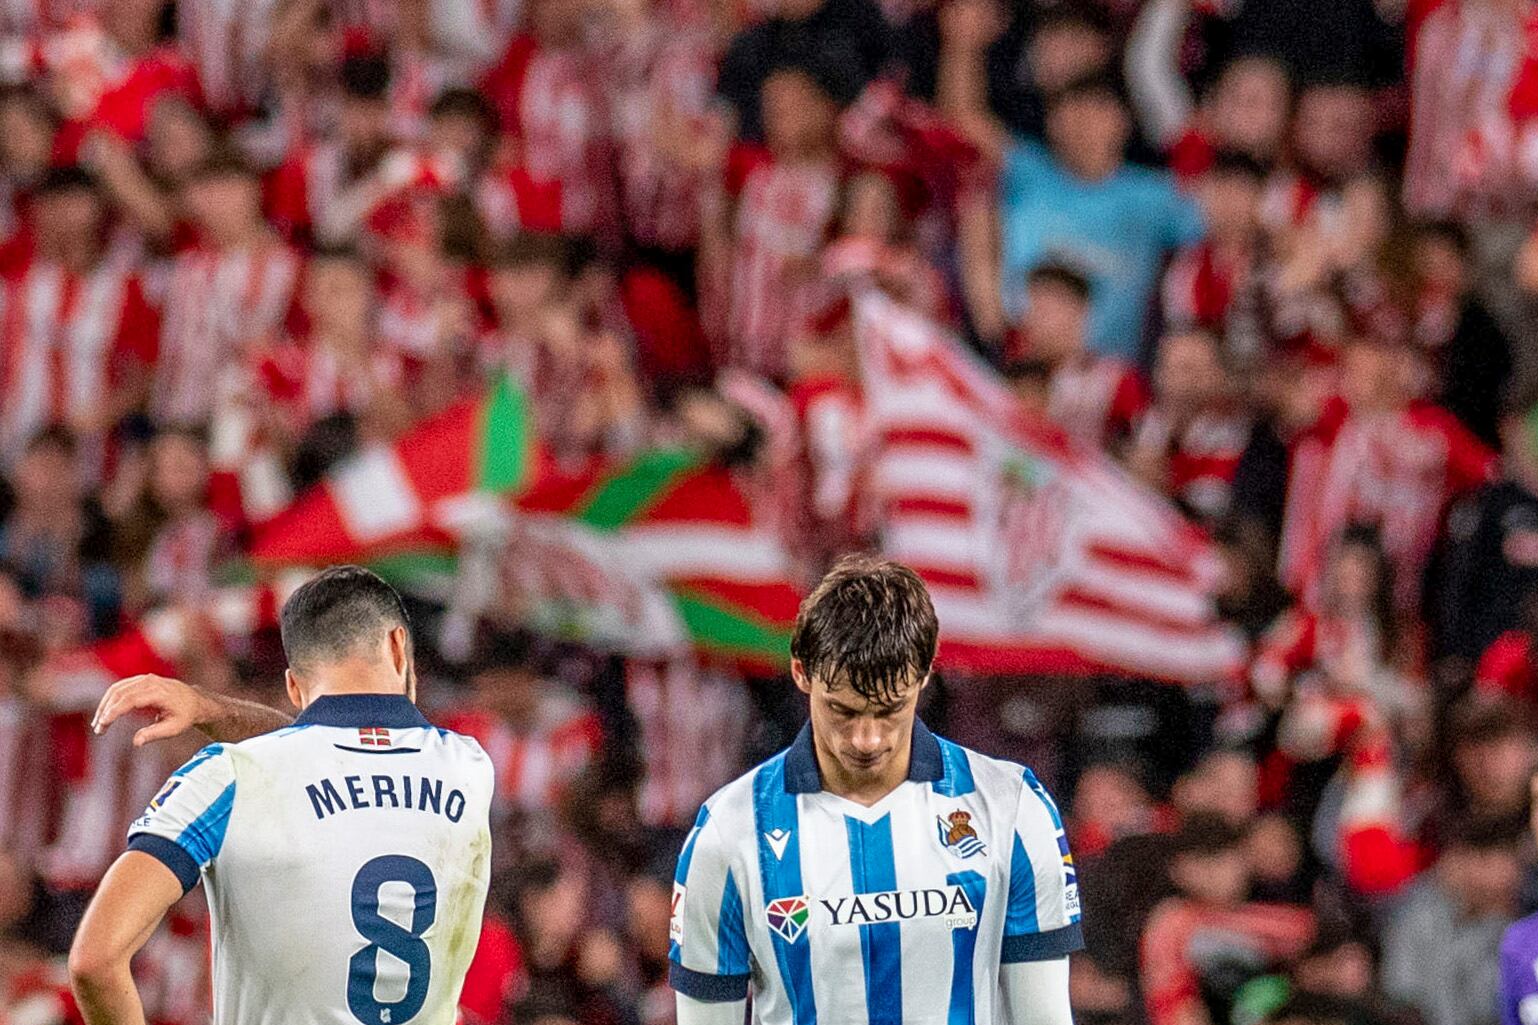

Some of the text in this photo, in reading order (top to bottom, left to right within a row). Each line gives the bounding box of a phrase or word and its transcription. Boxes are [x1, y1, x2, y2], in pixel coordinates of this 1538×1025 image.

[305, 774, 466, 824] MERINO
[820, 886, 975, 926] YASUDA
[945, 916, 976, 930] group
